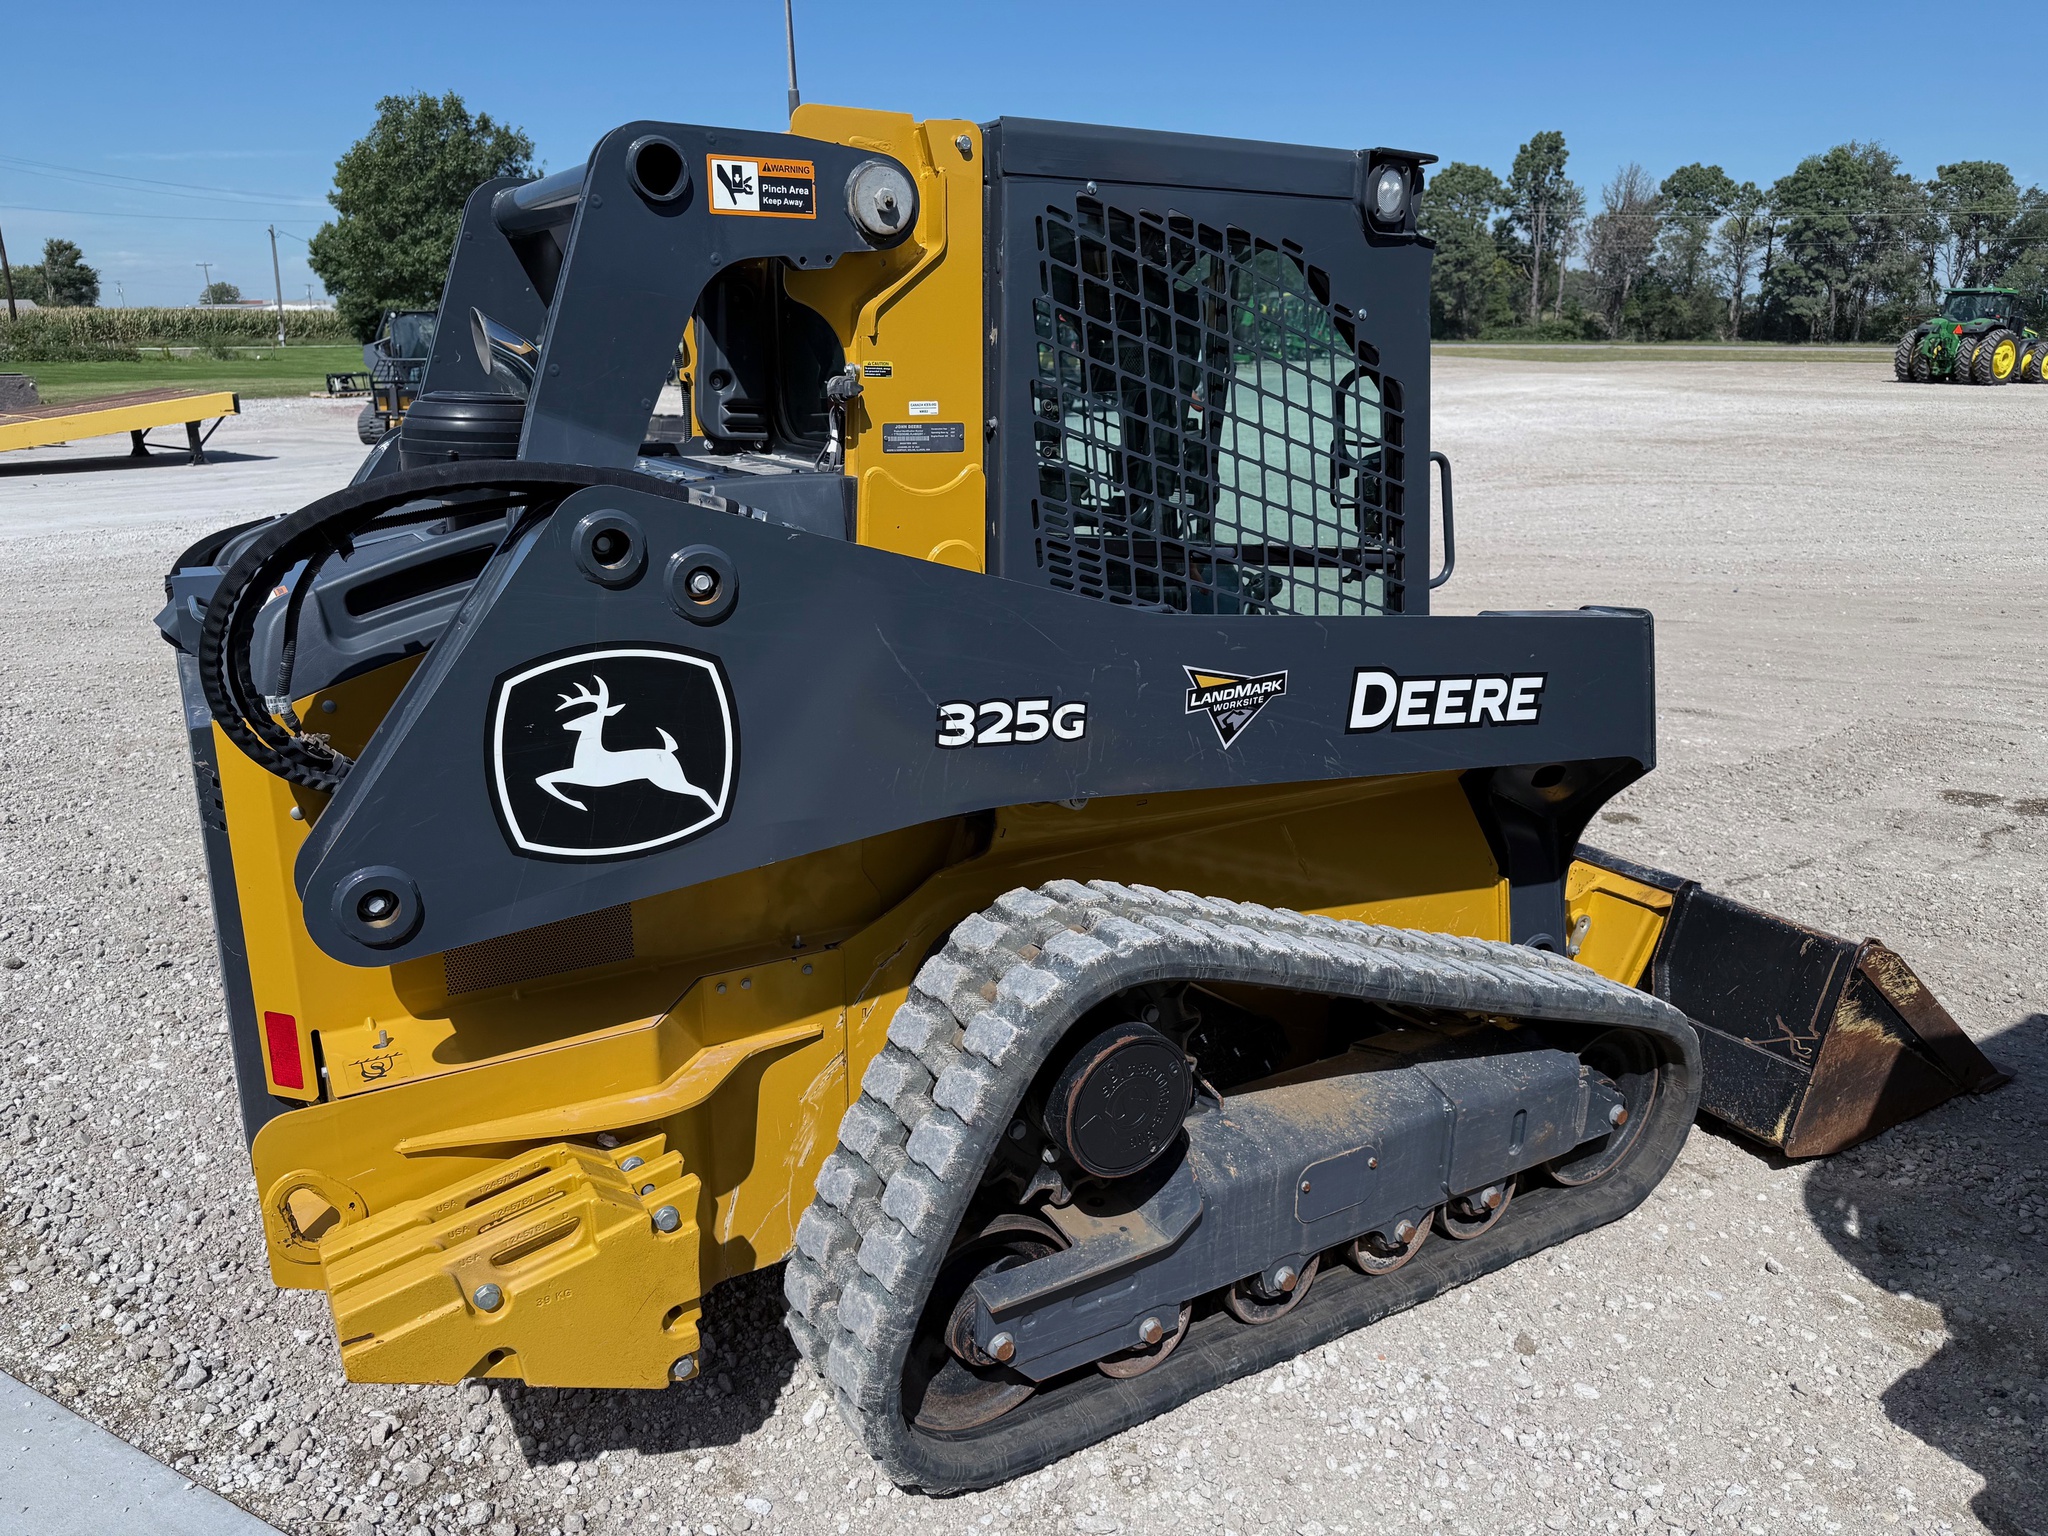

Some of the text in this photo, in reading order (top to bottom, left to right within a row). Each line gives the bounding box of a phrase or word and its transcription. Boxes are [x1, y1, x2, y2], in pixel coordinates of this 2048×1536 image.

[770, 164, 810, 174] WARNING
[762, 184, 809, 195] Pinch Area
[763, 196, 782, 207] Keep
[1190, 679, 1283, 707] LANDMARK
[1349, 671, 1544, 729] DEERE
[1213, 695, 1264, 712] WORKSITE
[936, 699, 1087, 747] 325G
[436, 1199, 458, 1213] USA
[447, 1225, 470, 1239] USA
[458, 1253, 482, 1268] USA
[536, 1288, 572, 1308] 39 KG
